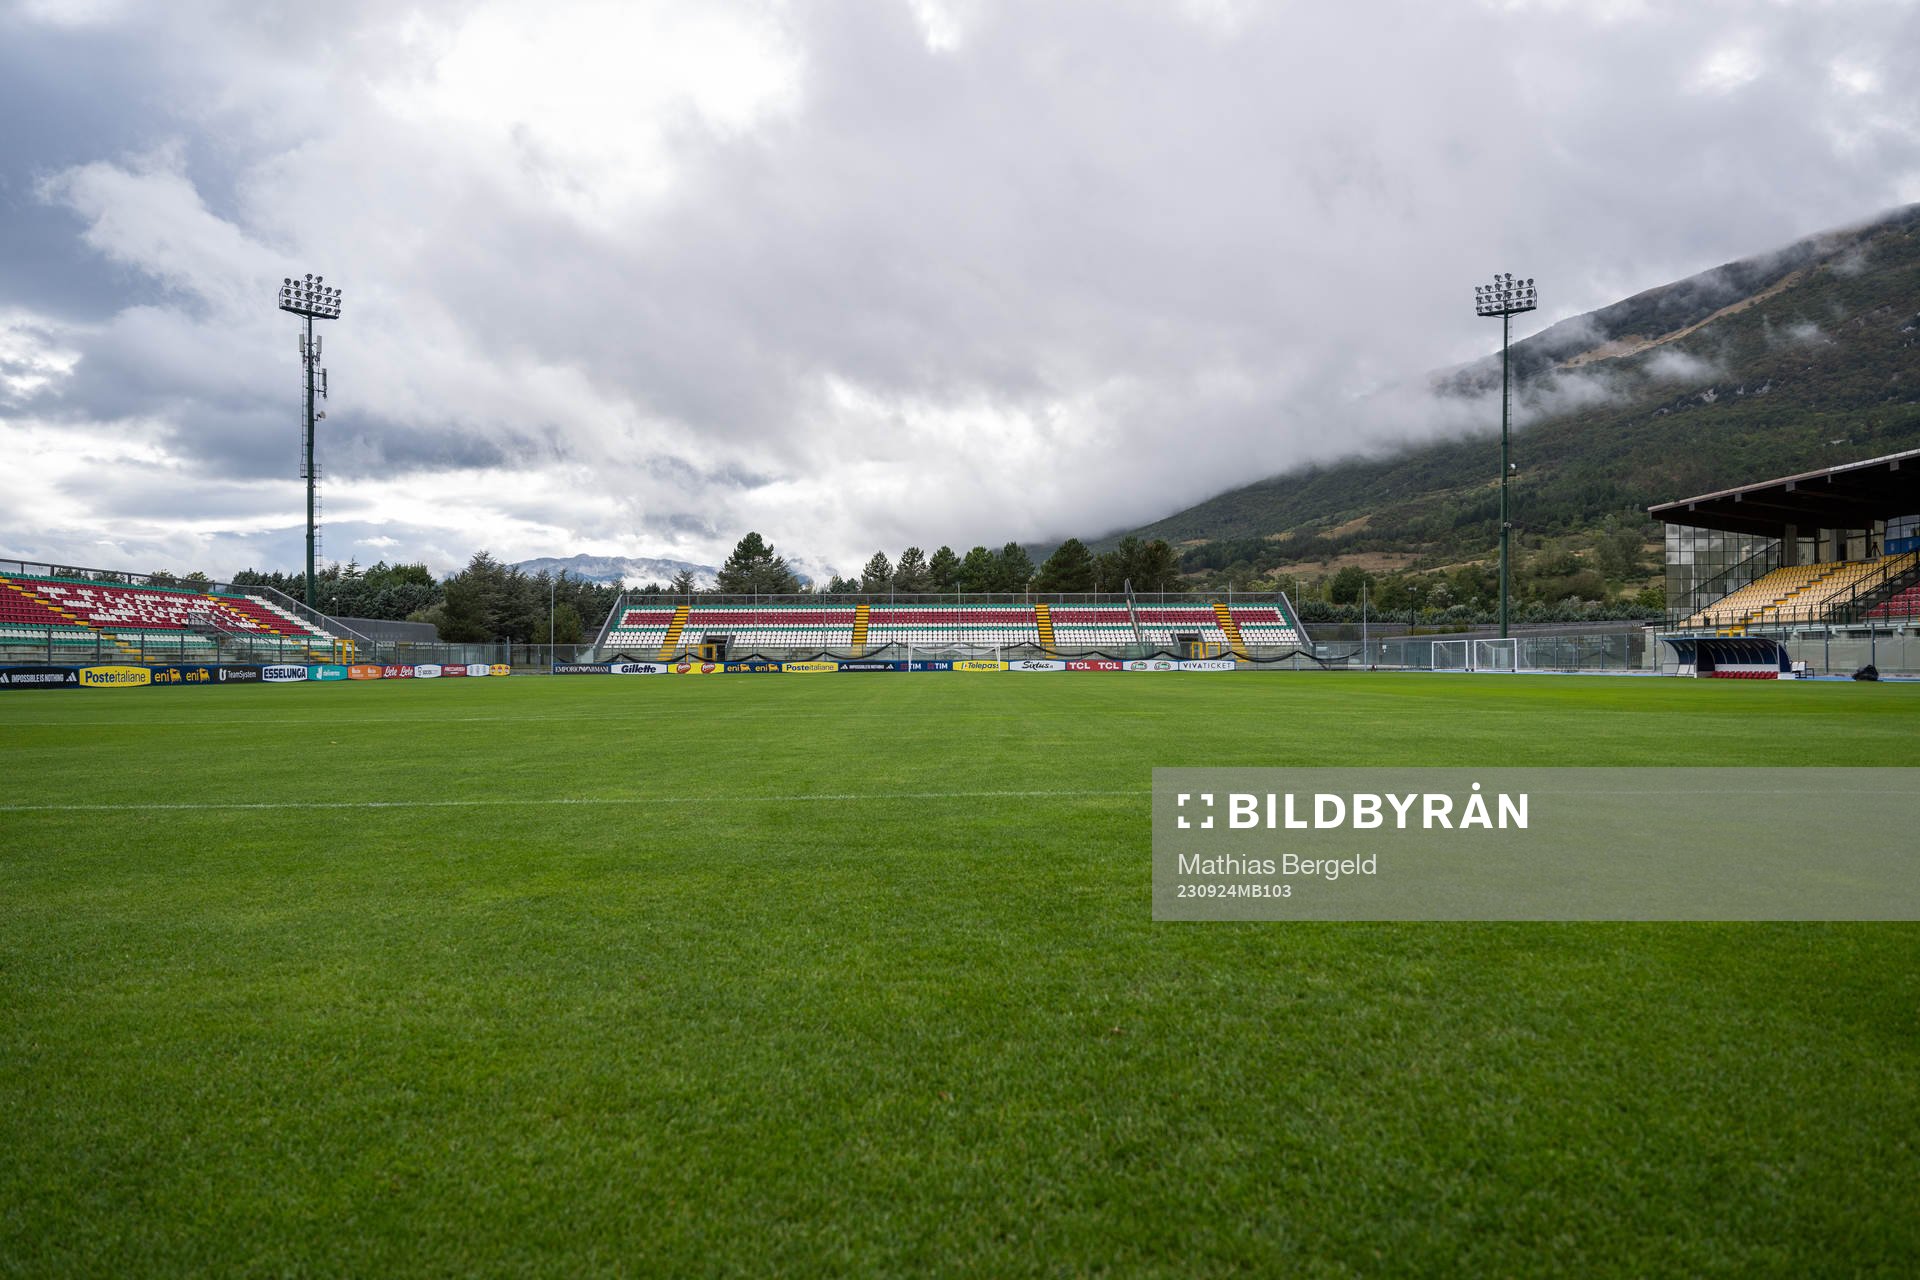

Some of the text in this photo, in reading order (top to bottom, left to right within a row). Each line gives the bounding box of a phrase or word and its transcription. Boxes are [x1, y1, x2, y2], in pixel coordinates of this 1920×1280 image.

[621, 664, 656, 673] Gillette
[727, 664, 740, 672] eni
[755, 664, 768, 672] eni
[1069, 662, 1119, 670] TCL TCL
[154, 670, 170, 682] eni
[186, 671, 199, 681] eni
[228, 671, 257, 680] TeamSystem
[264, 668, 306, 679] ESSELUNGA
[384, 666, 397, 677] Lete
[400, 666, 413, 677] Lete
